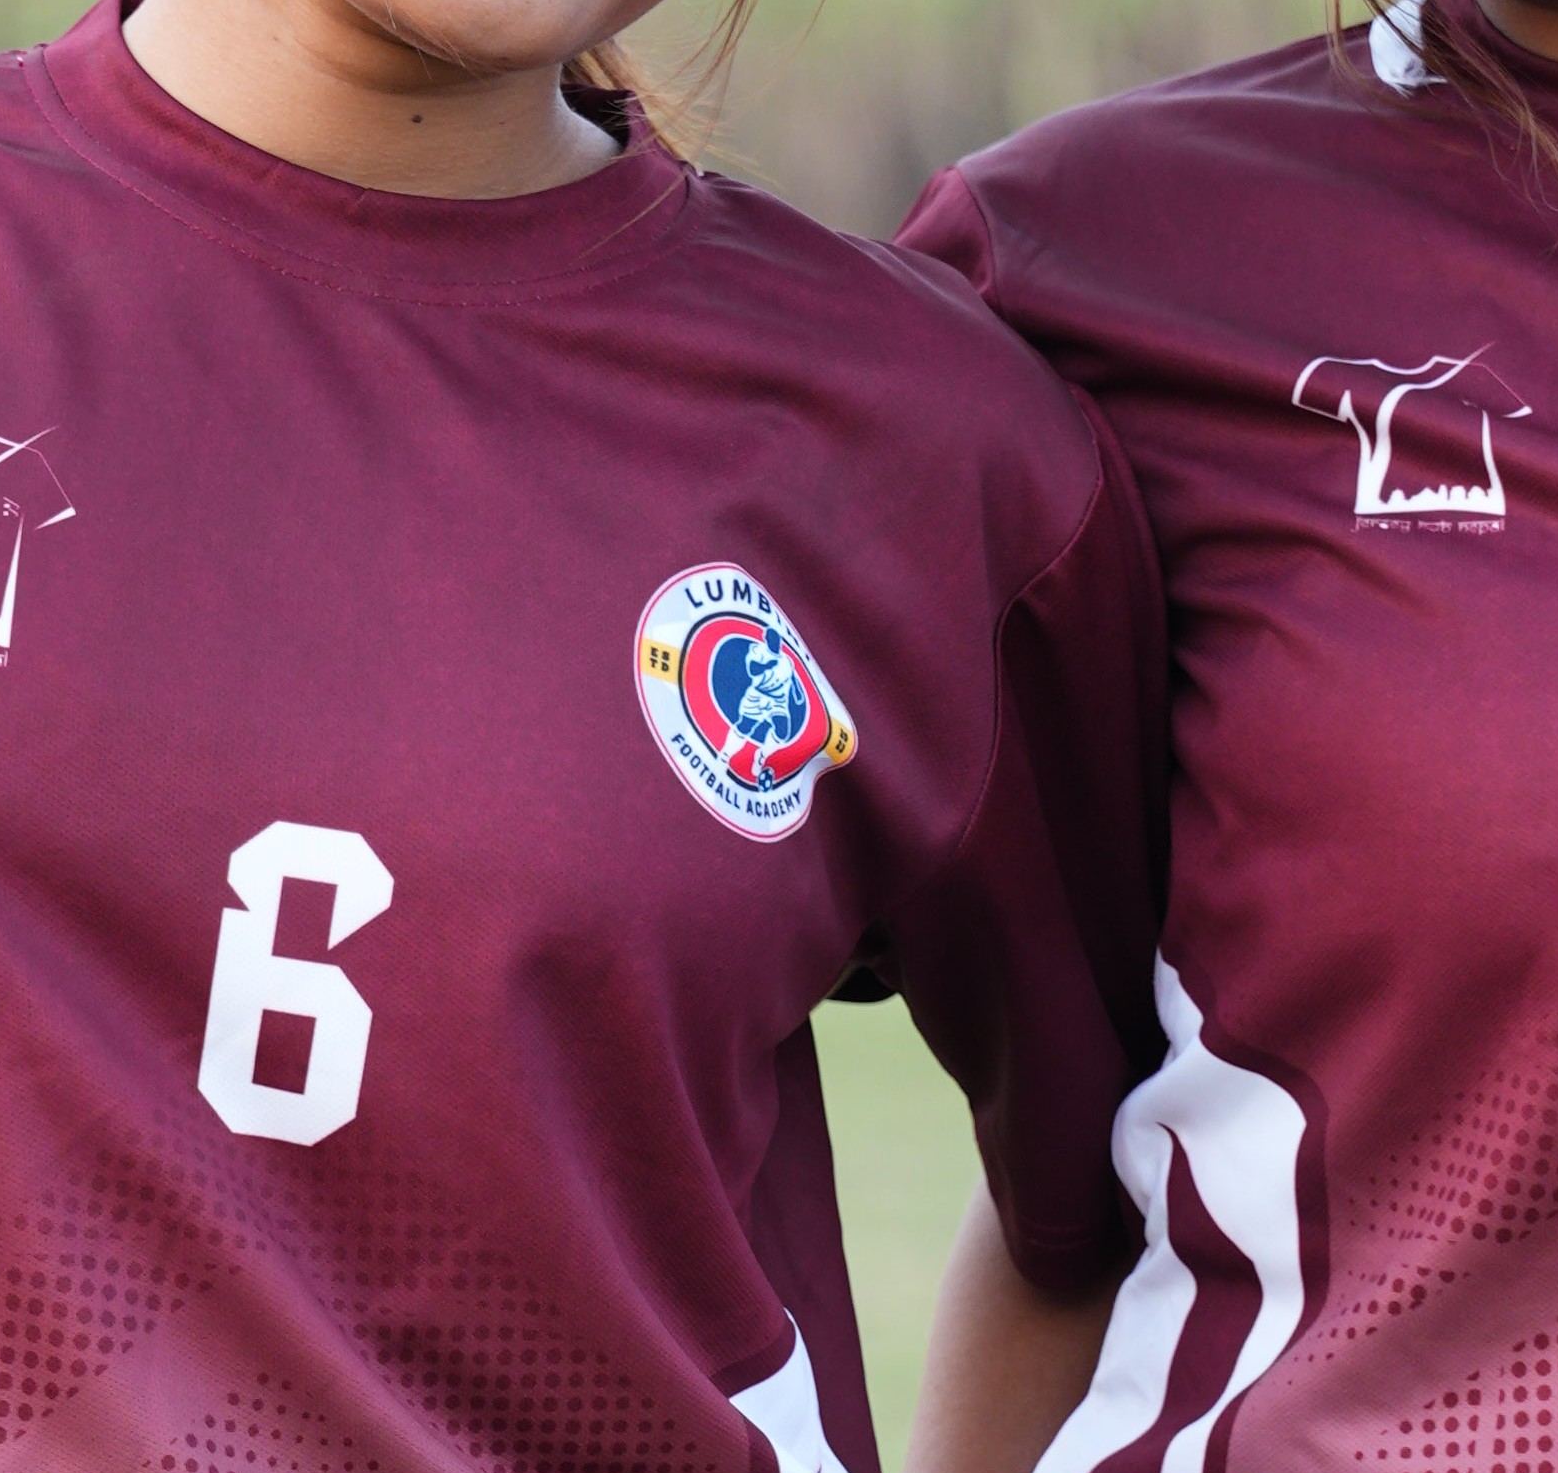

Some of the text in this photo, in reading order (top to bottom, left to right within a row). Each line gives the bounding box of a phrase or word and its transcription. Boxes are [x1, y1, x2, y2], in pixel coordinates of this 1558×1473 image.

[671, 733, 802, 819] FOOTBALL ACADEMY
[197, 821, 395, 1147] 6
